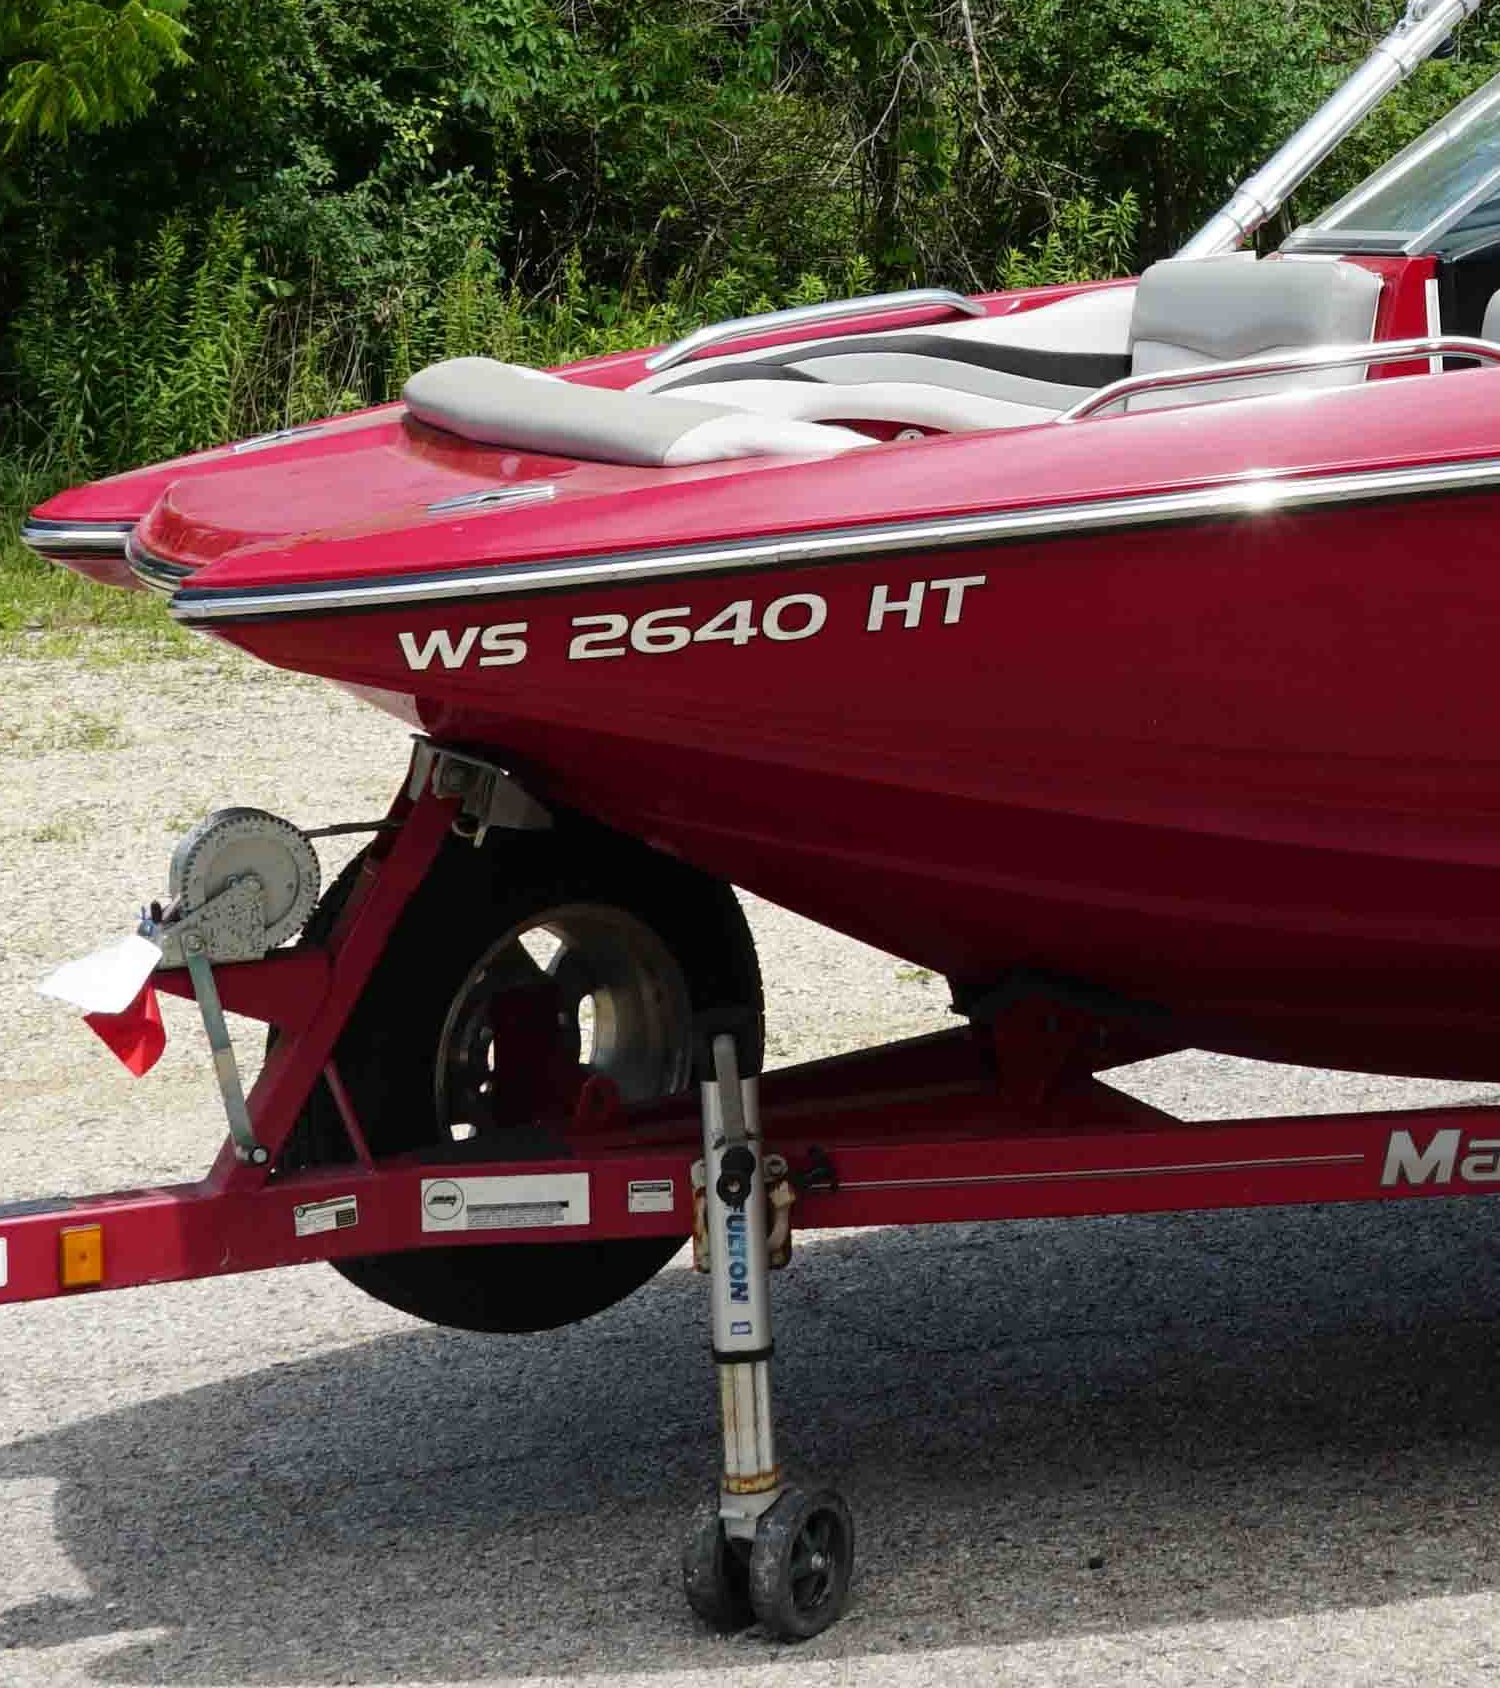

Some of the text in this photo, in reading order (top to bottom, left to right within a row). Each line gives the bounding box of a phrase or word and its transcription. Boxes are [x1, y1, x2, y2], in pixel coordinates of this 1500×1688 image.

[398, 575, 987, 672] WS 2640 HT
